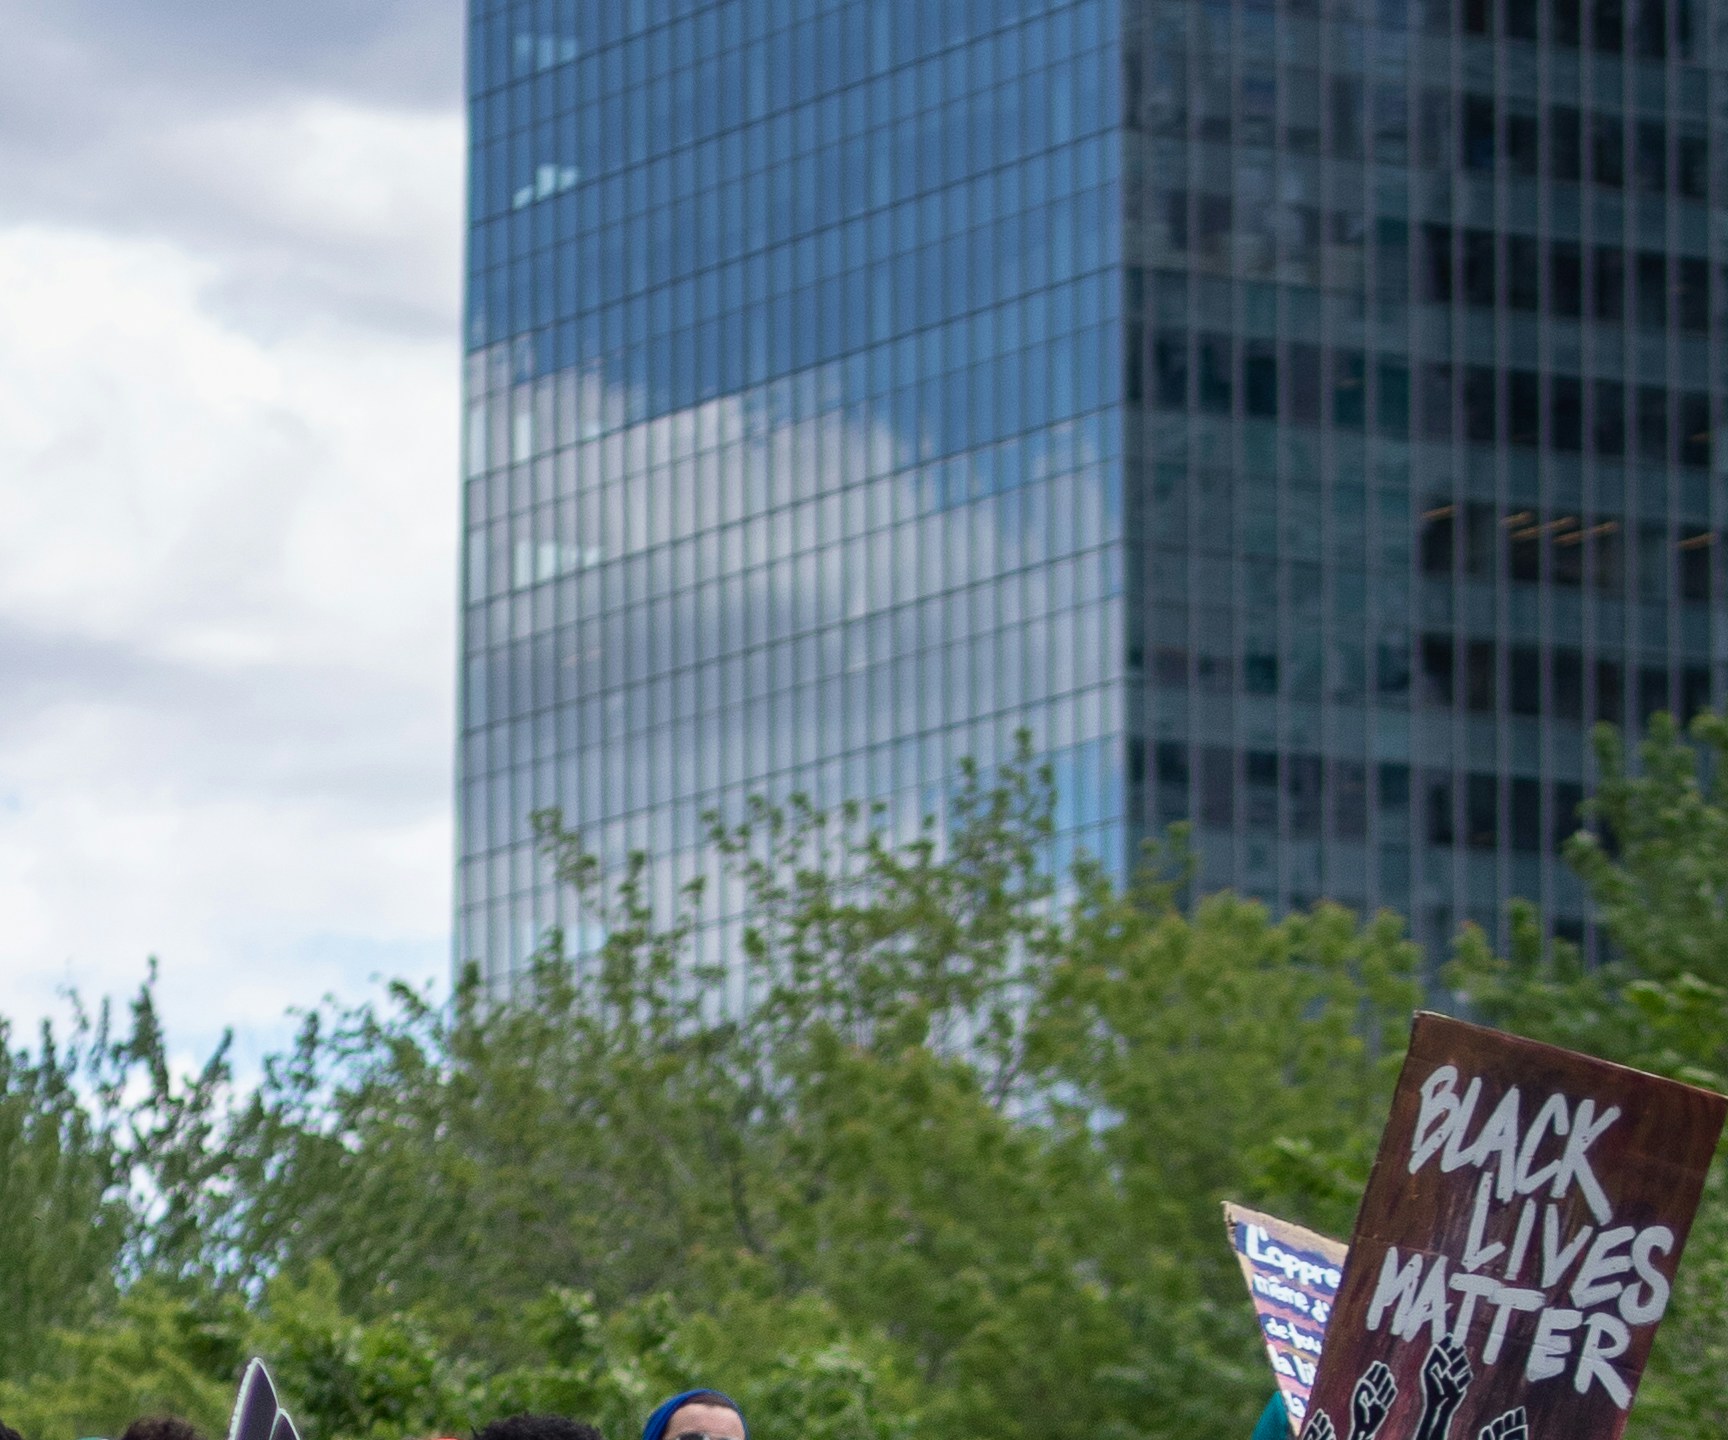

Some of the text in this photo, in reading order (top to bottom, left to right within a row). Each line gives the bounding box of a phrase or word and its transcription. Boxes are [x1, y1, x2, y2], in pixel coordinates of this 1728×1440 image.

[1408, 1065, 1621, 1225] BLACK
[1366, 1247, 1633, 1409] MATTER
[1464, 1172, 1674, 1325] LIVES
